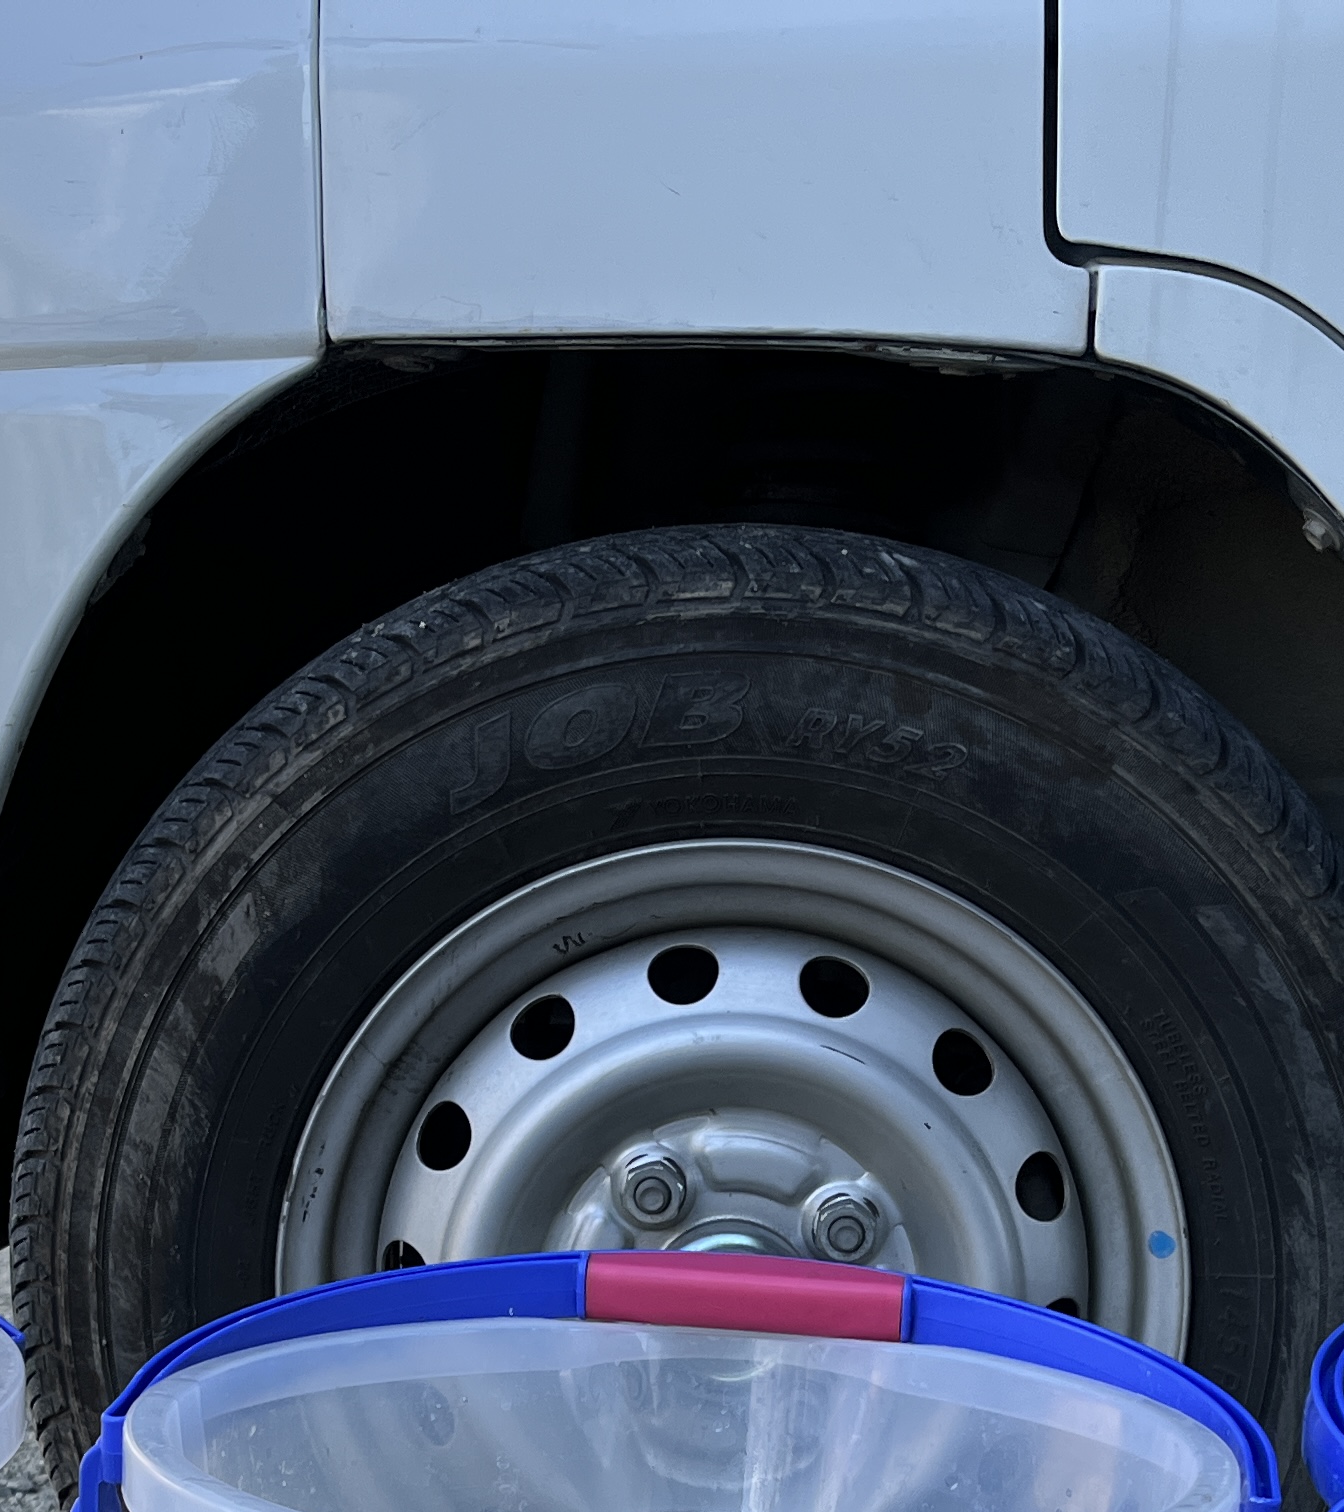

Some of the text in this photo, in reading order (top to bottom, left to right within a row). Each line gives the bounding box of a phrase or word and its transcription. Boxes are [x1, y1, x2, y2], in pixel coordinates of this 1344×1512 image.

[449, 671, 967, 814] JOB RY52
[646, 792, 801, 815] YOKOHAMA
[1154, 1009, 1208, 1098] TUBELESS
[1140, 1018, 1228, 1223] STEEL BELTED RADIAL
